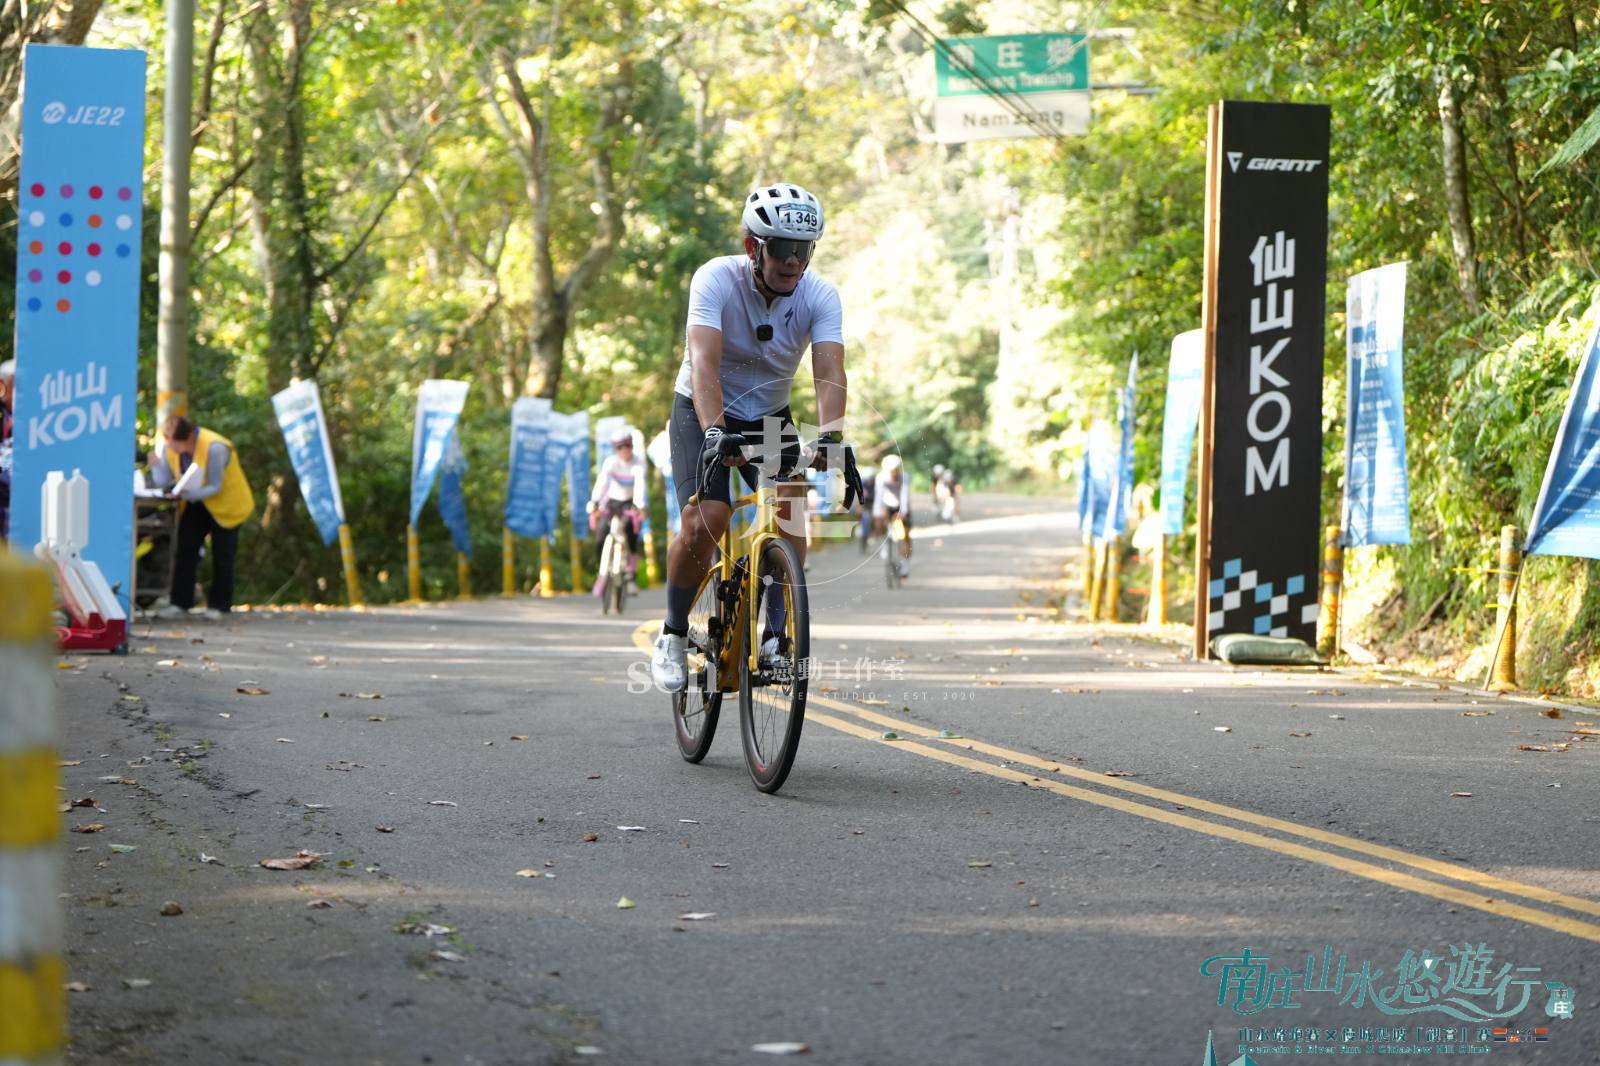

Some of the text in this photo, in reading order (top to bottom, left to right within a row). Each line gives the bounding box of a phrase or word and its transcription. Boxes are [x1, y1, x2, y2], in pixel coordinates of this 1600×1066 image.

[67, 105, 126, 126] JE22
[1246, 157, 1323, 172] GIANT
[39, 361, 107, 410] 仙山
[1245, 230, 1296, 496] 仙山 KOM
[28, 394, 122, 450] KOM
